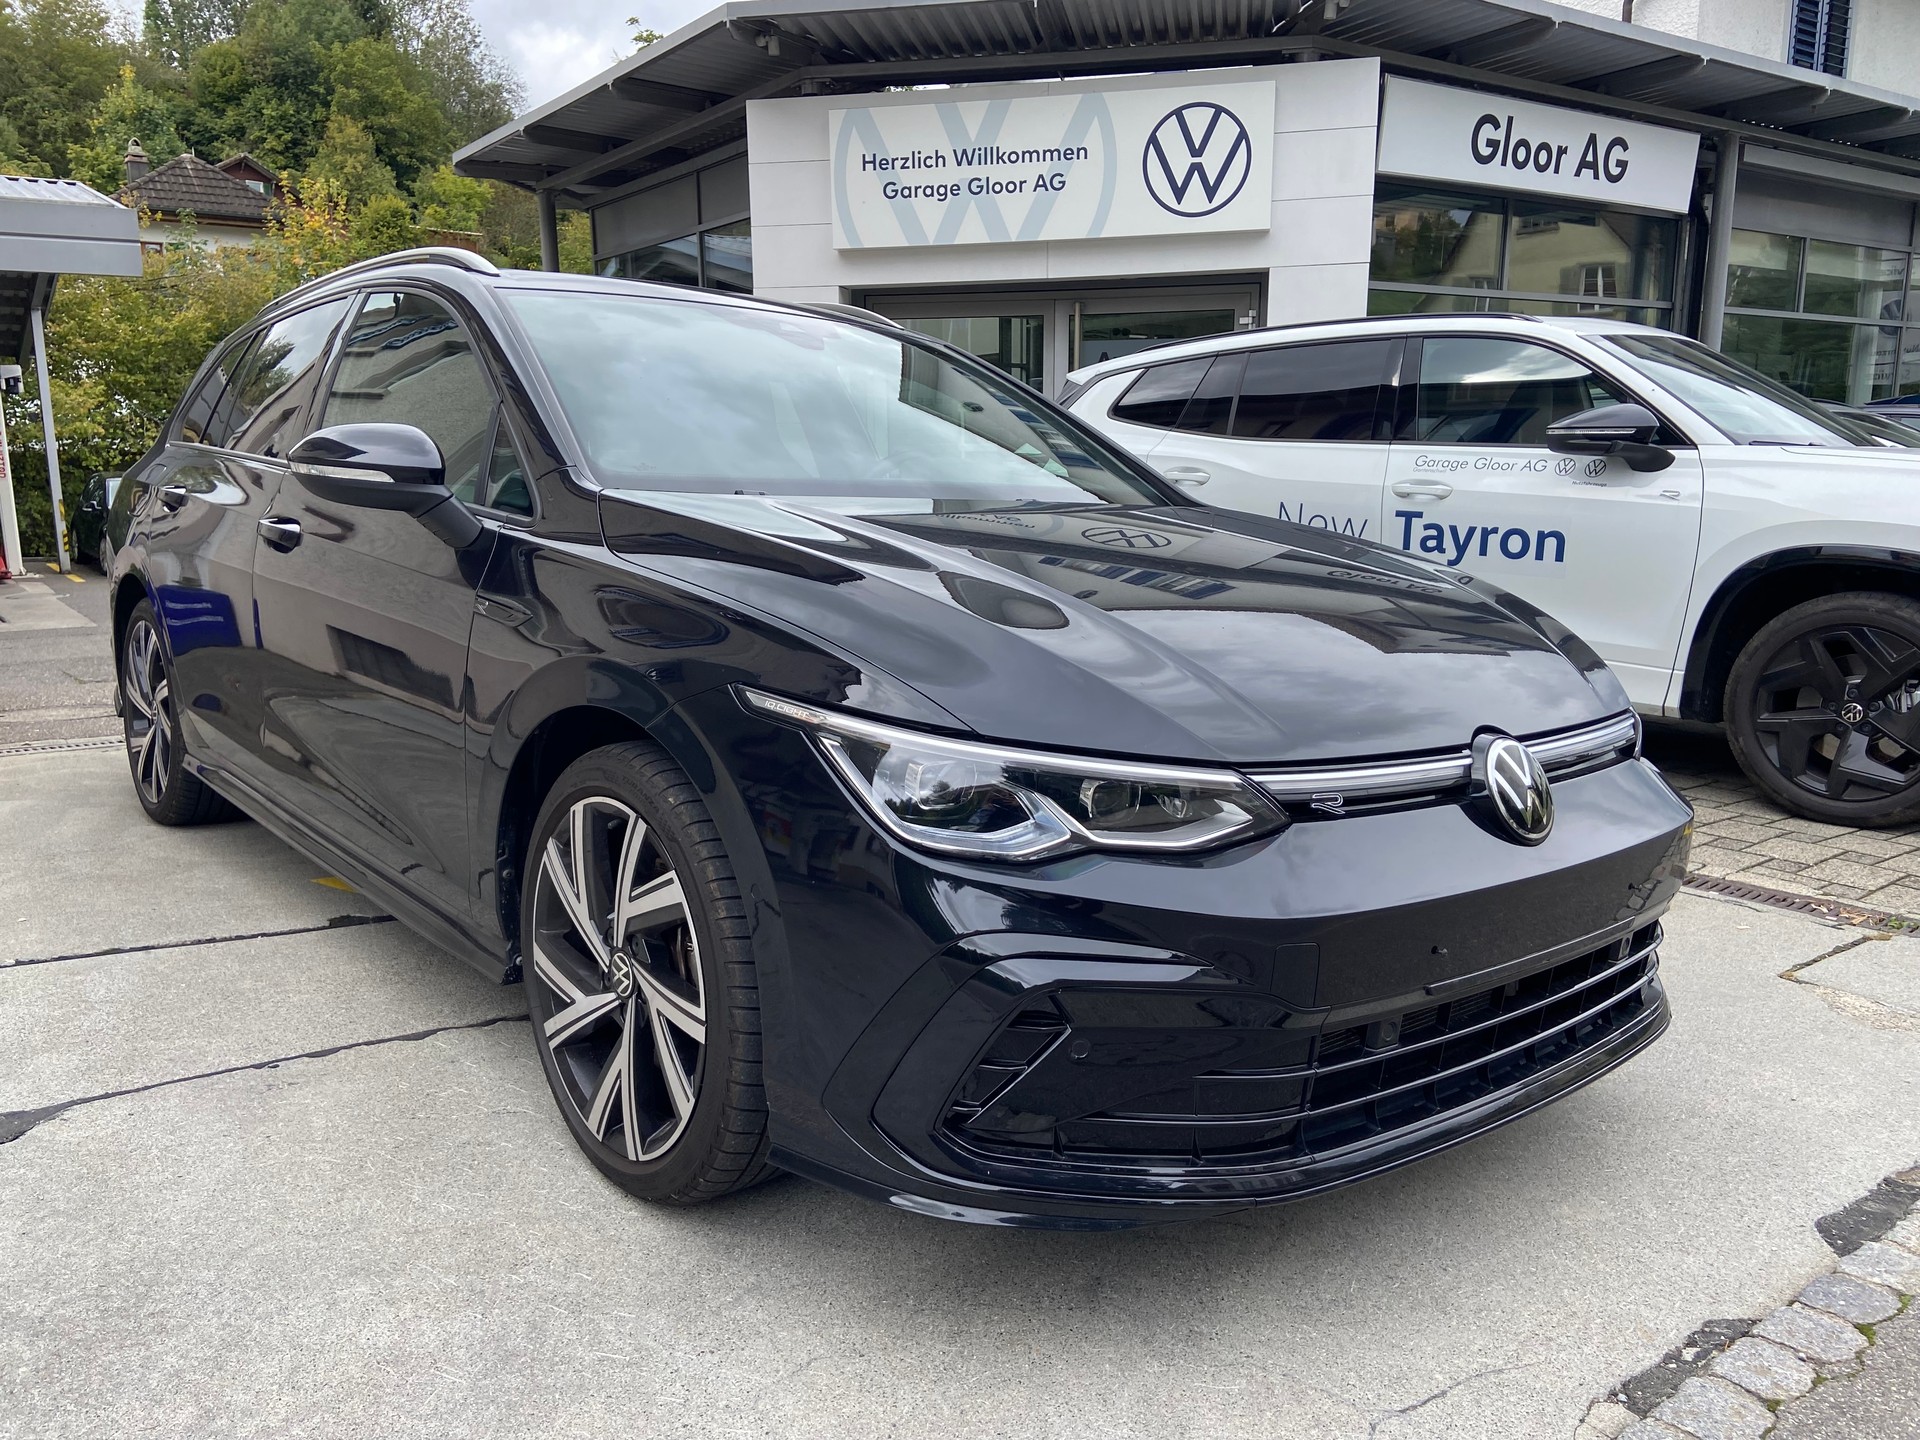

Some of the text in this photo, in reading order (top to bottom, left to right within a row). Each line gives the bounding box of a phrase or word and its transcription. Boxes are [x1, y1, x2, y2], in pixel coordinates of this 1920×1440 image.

[861, 144, 1089, 173] Herzlich Willkommen
[1471, 113, 1630, 184] Gloor AG
[882, 172, 1067, 203] Garage Gloor AG
[1414, 454, 1548, 473] Garage Gloor AG
[1395, 510, 1566, 567] Tayron
